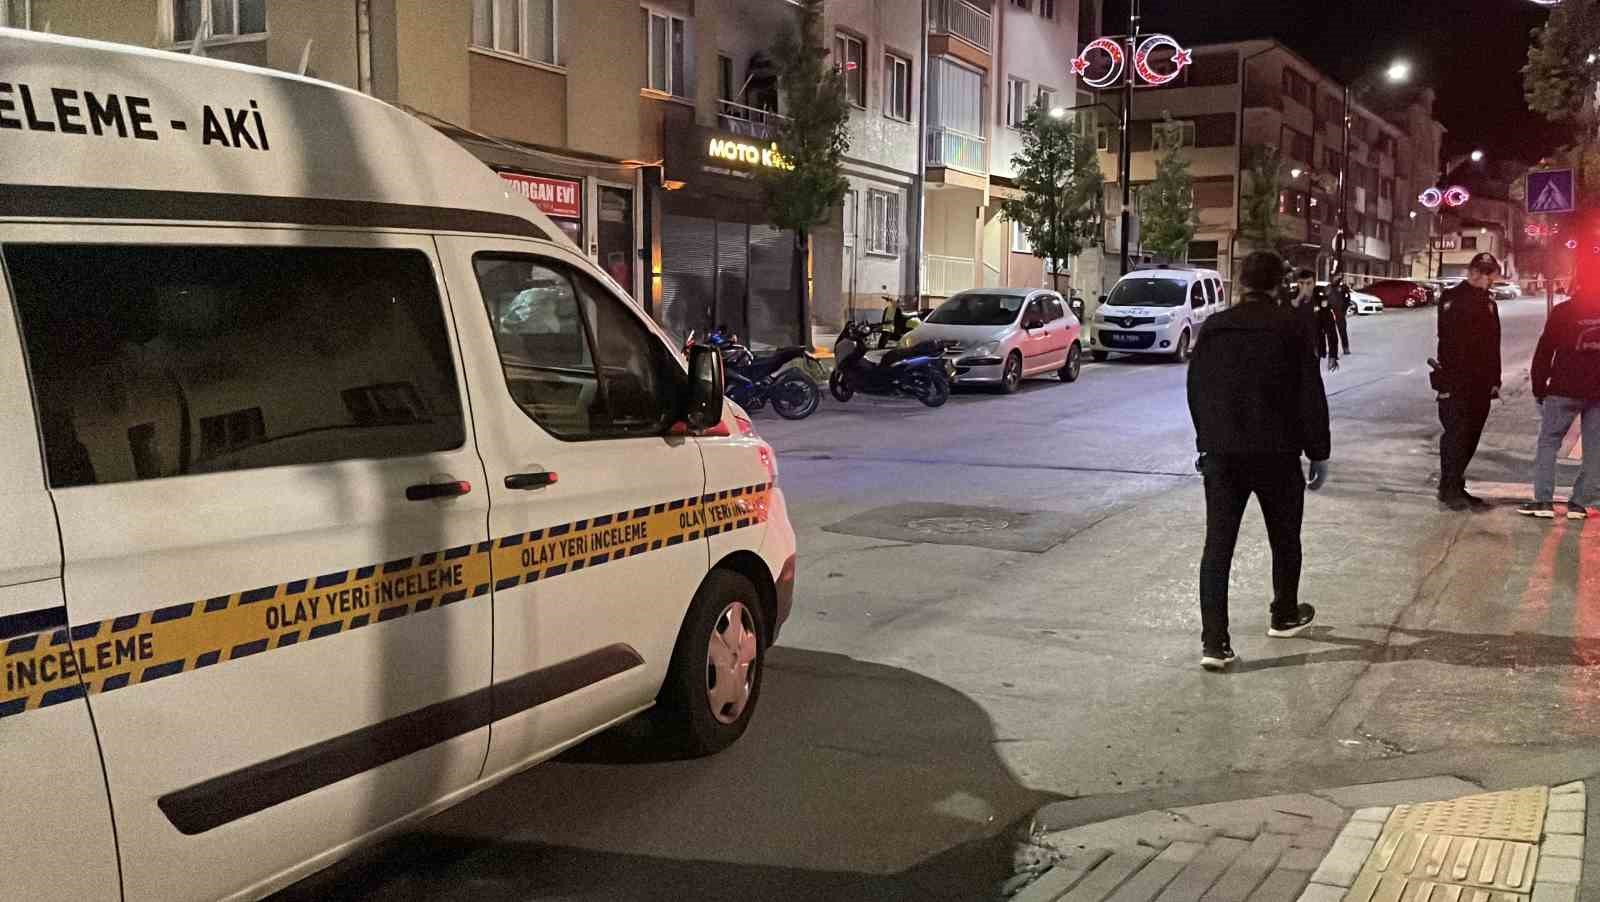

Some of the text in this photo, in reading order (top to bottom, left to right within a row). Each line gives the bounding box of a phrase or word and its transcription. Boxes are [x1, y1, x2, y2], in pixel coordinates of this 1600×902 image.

[170, 120, 187, 131] -
[202, 99, 270, 151] AKİ
[709, 138, 759, 164] MOTO
[557, 184, 575, 204] EVİ
[680, 510, 706, 528] OLAY
[521, 543, 556, 567] OLAY
[591, 521, 647, 551] İNCELEME
[266, 564, 463, 630] OLAY YERİ İNCELEME
[7, 633, 153, 691] İNCELEME
